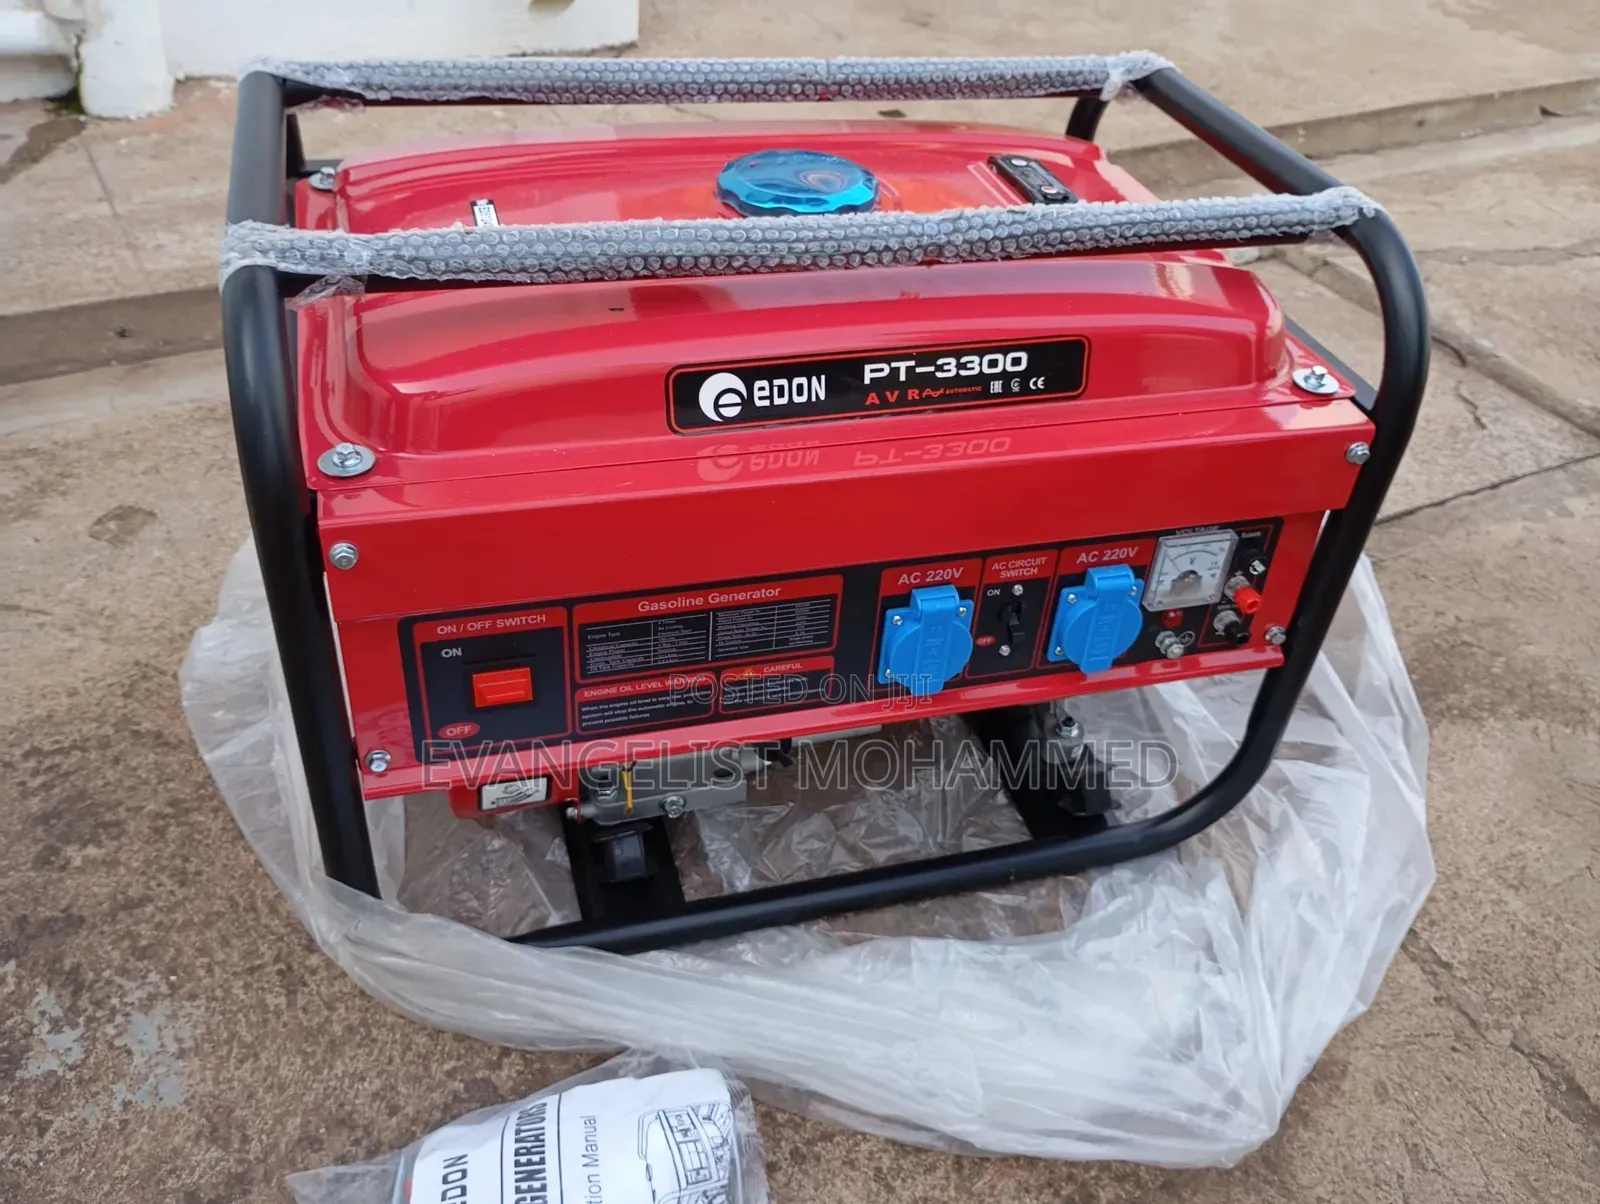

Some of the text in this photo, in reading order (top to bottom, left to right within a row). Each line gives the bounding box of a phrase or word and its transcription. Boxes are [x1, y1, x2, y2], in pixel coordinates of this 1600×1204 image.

[864, 351, 1028, 385] PT-3300
[945, 386, 982, 394] AUTOMATIC
[1076, 546, 1139, 564] AC 220V
[992, 556, 1047, 571] AC CIRCUIT
[898, 567, 963, 585] AC 220V
[999, 567, 1038, 579] SWITCH
[637, 594, 704, 612] Gasoline
[708, 587, 781, 604] Generator
[987, 589, 1000, 597] ON
[436, 625, 457, 635] ON
[467, 620, 493, 631] OFF
[496, 614, 546, 628] SWITCH
[977, 637, 993, 645] OFF
[441, 647, 462, 658] ON
[763, 663, 802, 673] CAREFUL
[584, 686, 617, 698] ENGINE
[620, 684, 634, 693] OIL
[635, 680, 664, 691] LEVEL
[582, 712, 603, 720] system
[582, 712, 650, 727] prevent possible failures
[446, 725, 472, 737] OFF
[580, 1115, 600, 1168] Manual
[441, 1153, 468, 1204] DON
